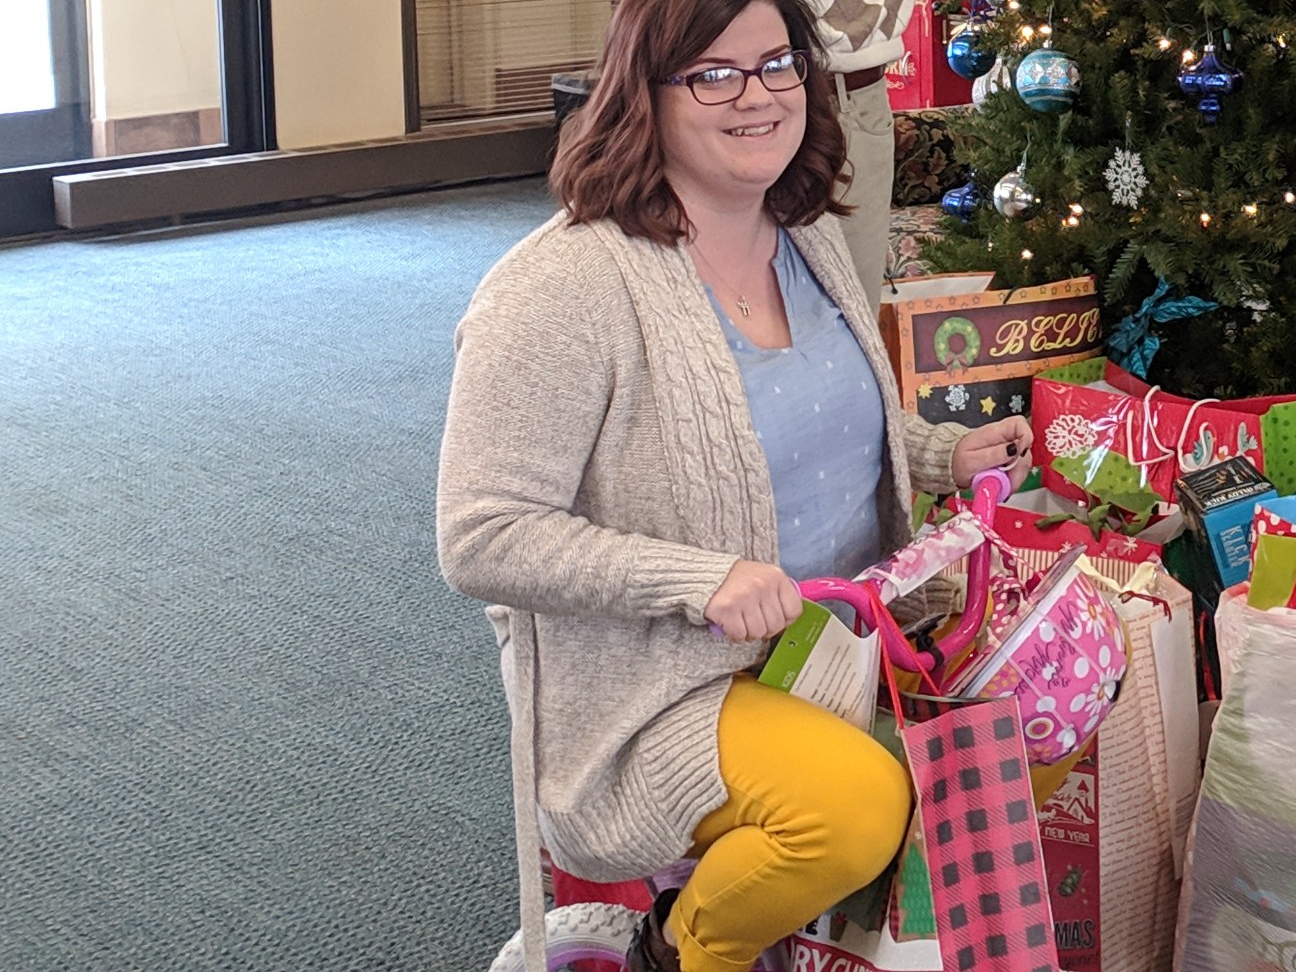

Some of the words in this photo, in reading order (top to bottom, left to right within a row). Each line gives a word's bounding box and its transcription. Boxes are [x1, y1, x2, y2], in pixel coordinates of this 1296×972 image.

[1229, 525, 1250, 565] KICK
[1045, 826, 1065, 839] NEW
[1053, 919, 1095, 950] MAS
